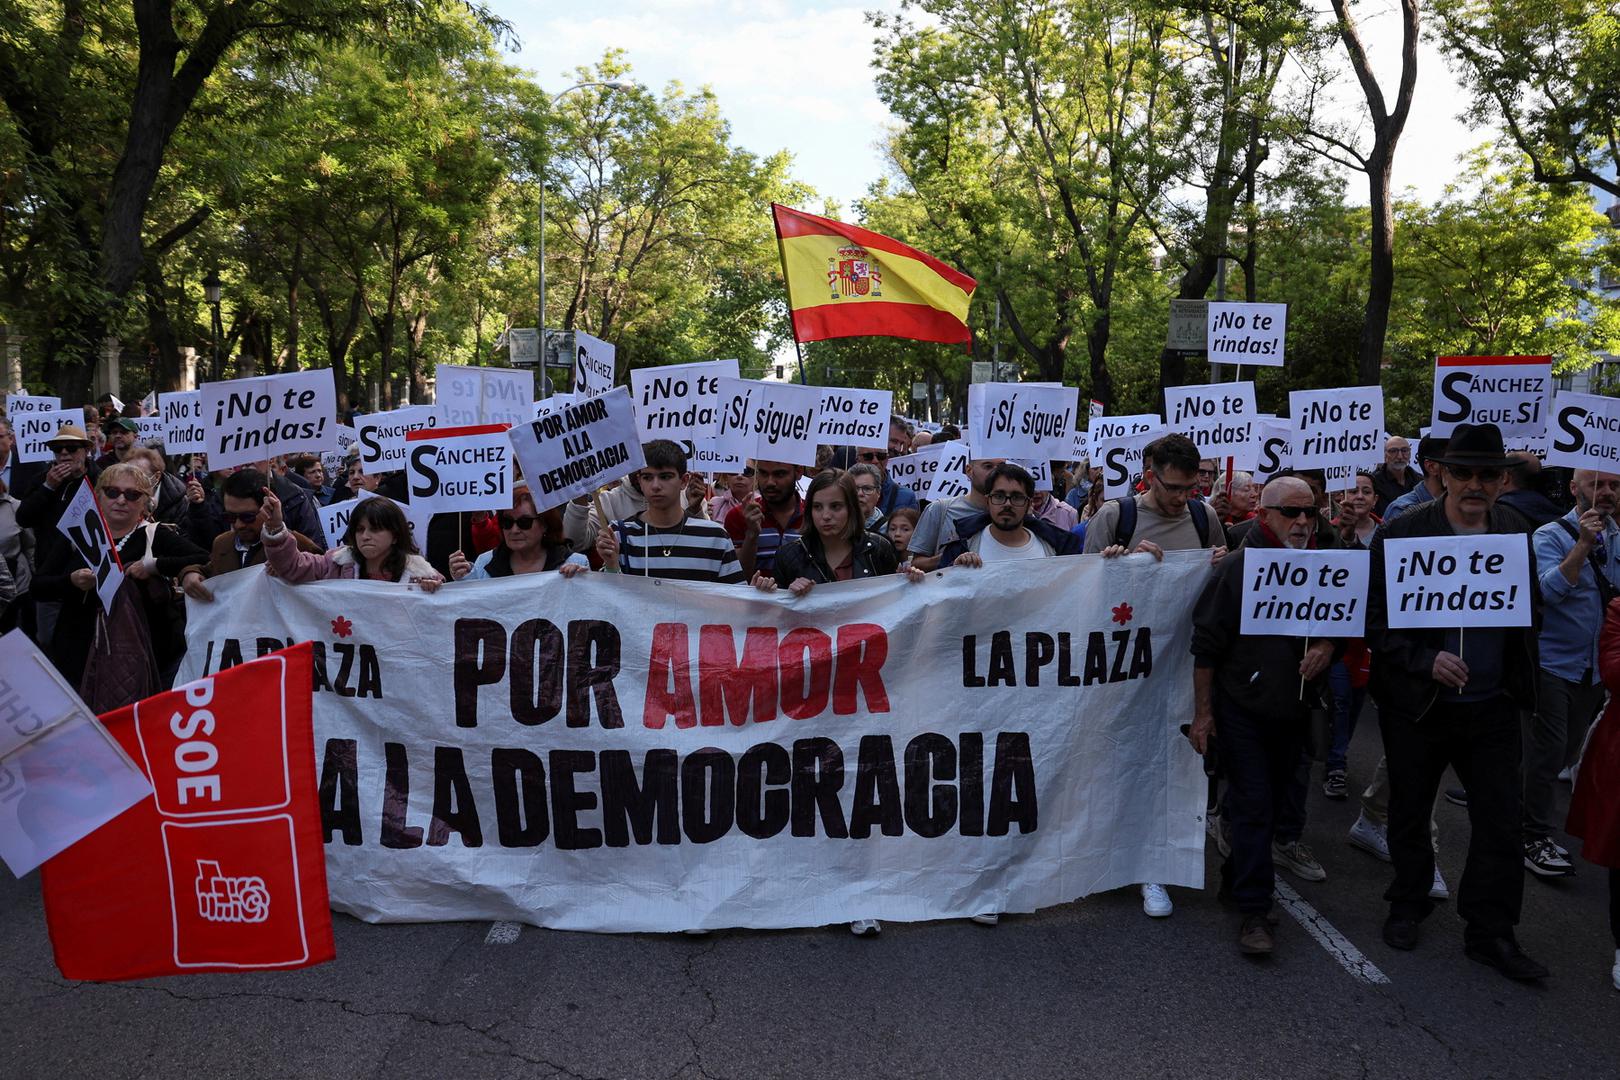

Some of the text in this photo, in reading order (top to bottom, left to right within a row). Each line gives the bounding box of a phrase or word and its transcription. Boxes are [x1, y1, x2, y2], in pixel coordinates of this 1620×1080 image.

[1213, 311, 1245, 332] ¡No
[1252, 313, 1273, 330] te
[1213, 335, 1278, 355] rindas!
[643, 375, 719, 406] ¡No te
[10, 400, 52, 412] ¡No te
[165, 400, 201, 424] ¡No t
[214, 388, 316, 427] ¡No te
[647, 404, 717, 430] rinda
[720, 389, 814, 444] ¡SÍ, sigue!
[820, 395, 879, 415] ¡No te
[987, 393, 1018, 439] ¡SÍ,
[1021, 403, 1070, 444] sigue!
[1175, 395, 1244, 424] ¡No te
[1300, 400, 1372, 430] ¡No te
[21, 419, 51, 438] ¡No
[136, 422, 150, 432] No
[169, 424, 205, 444] rinda
[219, 416, 327, 454] rindas!
[531, 398, 609, 444] POR AMOR
[818, 418, 883, 438] rindas!
[1093, 423, 1126, 442] ¡No
[562, 430, 593, 460] A LA
[1073, 436, 1086, 445] No
[1303, 429, 1378, 455] rindas!
[538, 442, 630, 495] DEMOCRACIA
[889, 460, 939, 479] No te
[944, 455, 967, 474] ¡N
[1253, 561, 1350, 592] ¡No te
[1397, 550, 1505, 583] ¡No te
[1253, 595, 1357, 622] rindas!
[1400, 584, 1518, 612] rindas!
[963, 627, 1153, 687] LA PLAZA
[454, 617, 891, 729] POR AMOR
[169, 678, 221, 806] PSOE
[320, 732, 1038, 850] A LA DEMOCRACIA
